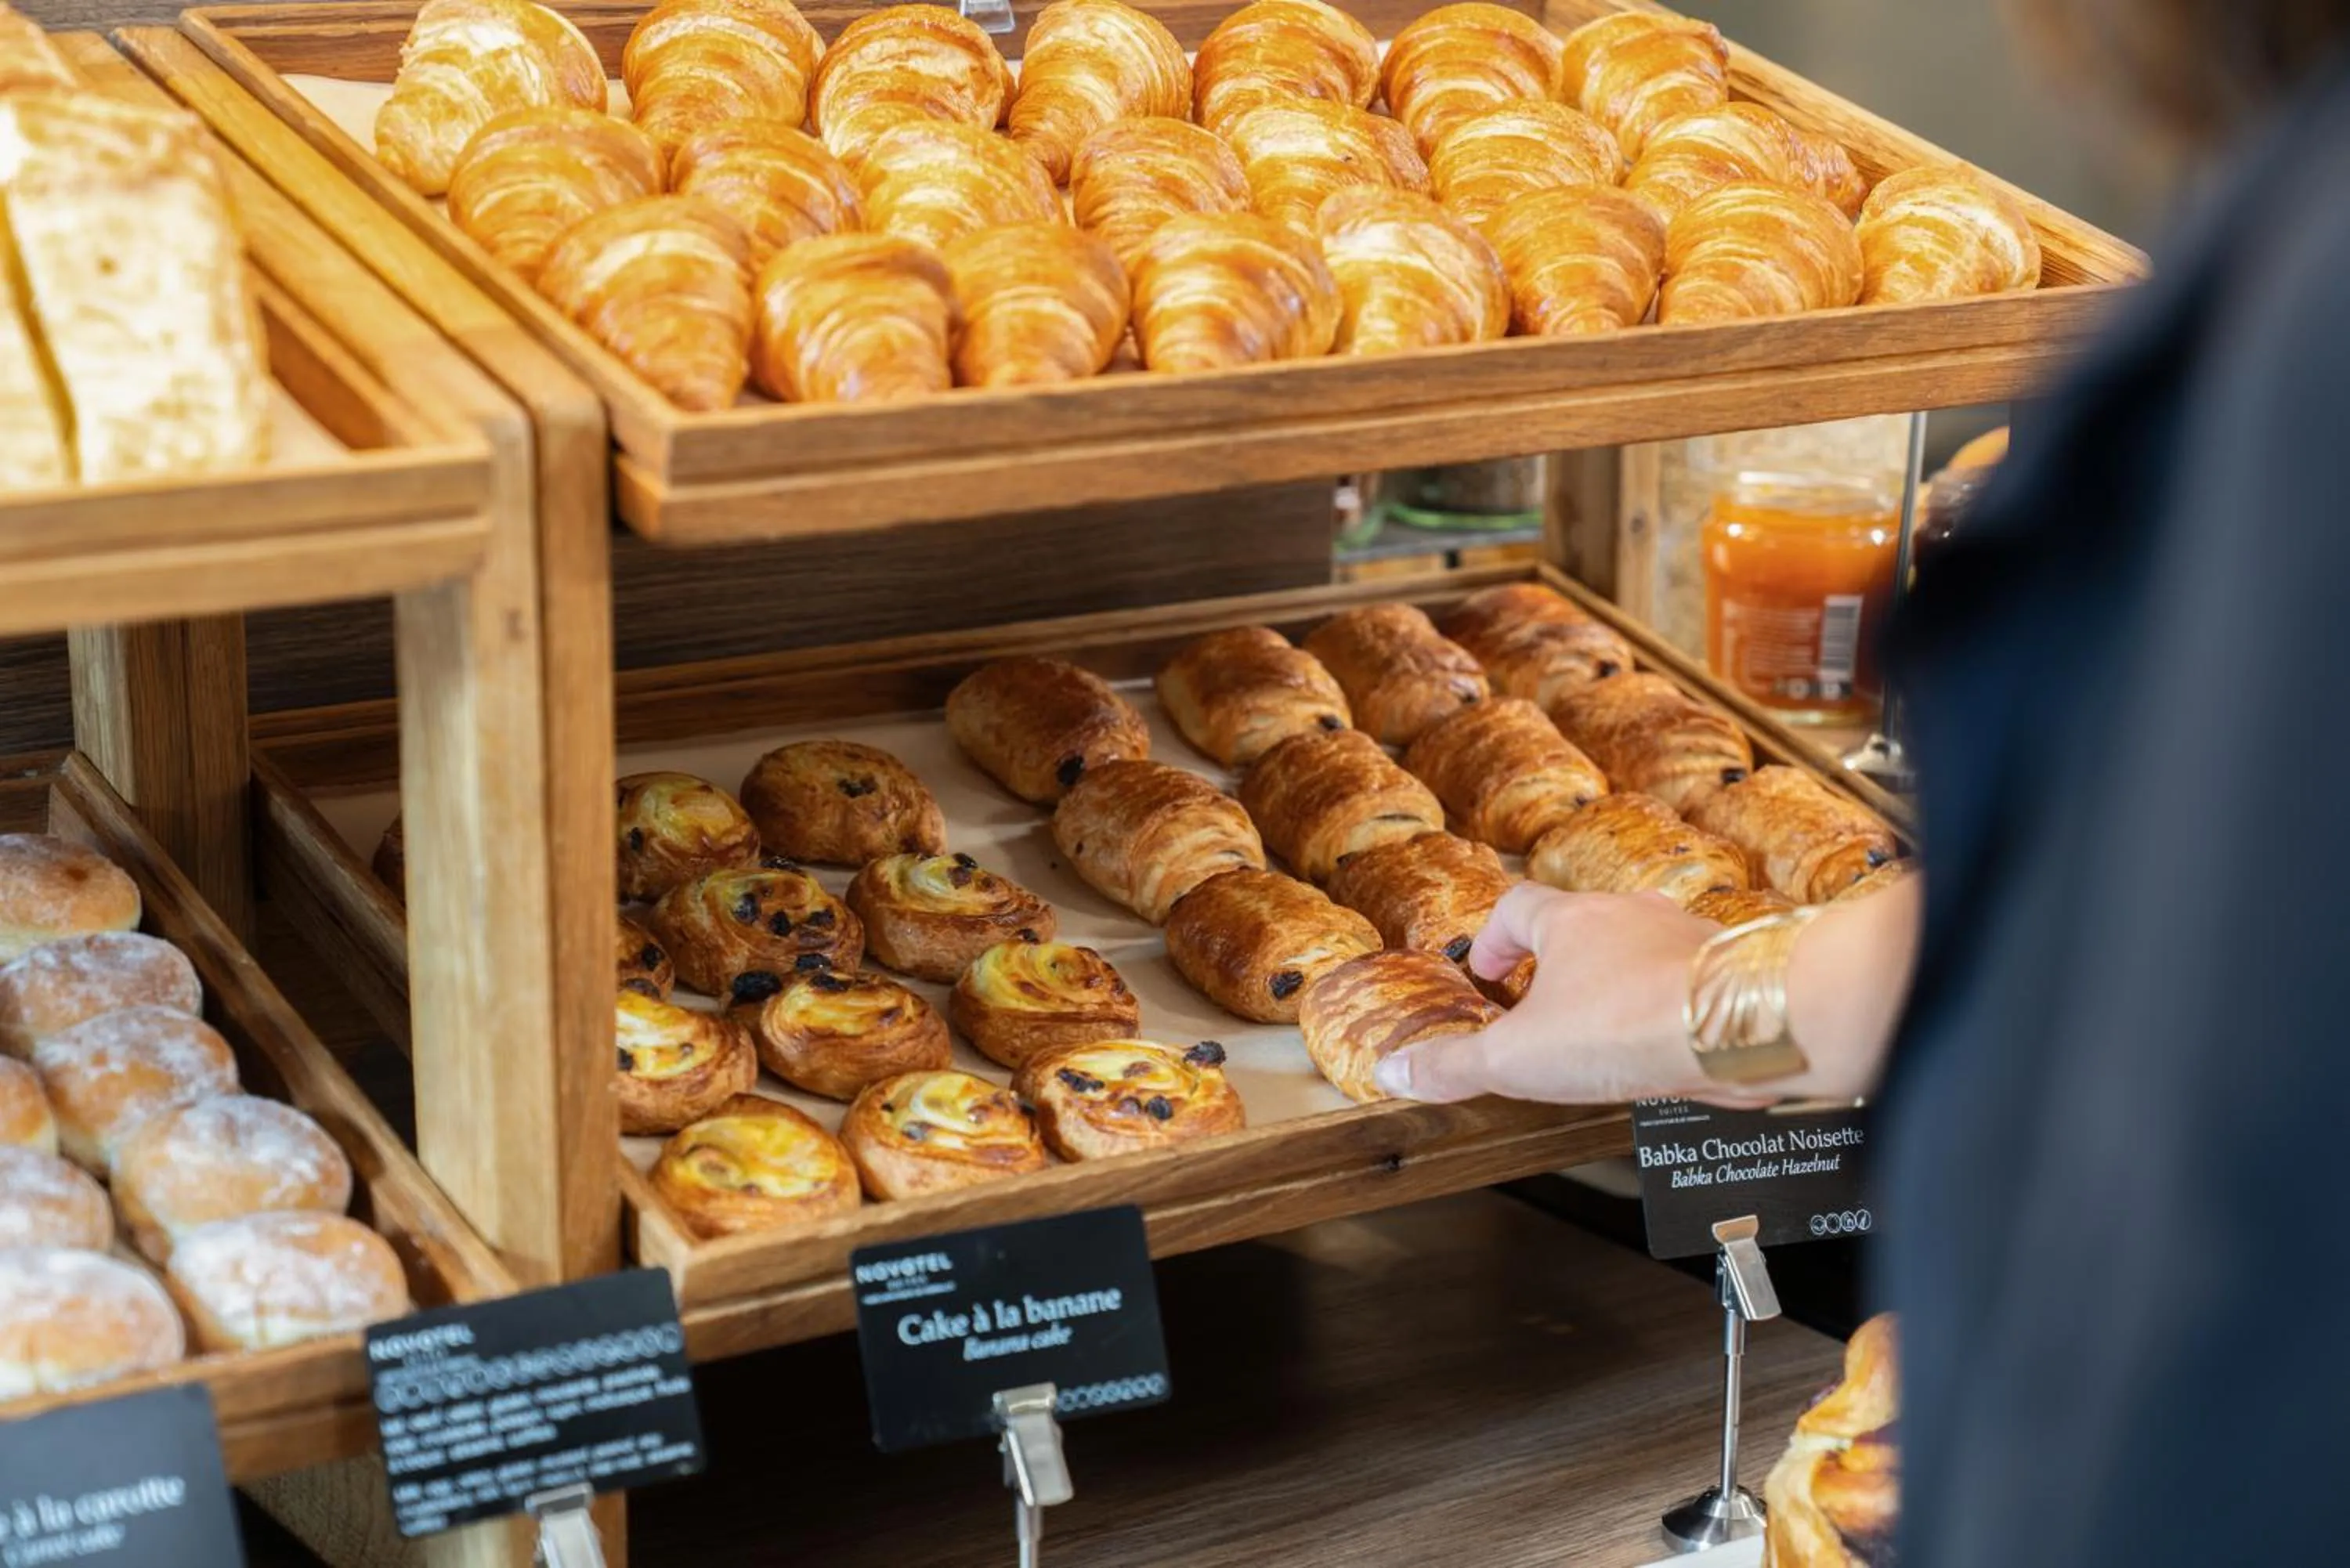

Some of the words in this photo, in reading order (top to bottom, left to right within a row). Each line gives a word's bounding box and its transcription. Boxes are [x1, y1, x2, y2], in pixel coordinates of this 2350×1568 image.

[1640, 1143, 1697, 1168] Babka
[1702, 1134, 1786, 1161] Chocolat
[1789, 1127, 1864, 1151] Noisette
[1671, 1165, 1712, 1188] Babka
[1716, 1158, 1780, 1184] Chocolate
[1782, 1153, 1841, 1176] Hazelnut
[855, 1252, 953, 1284] NOVOTEL
[898, 1310, 970, 1346] Cake
[972, 1302, 991, 1333] à
[994, 1298, 1021, 1330] la
[1023, 1288, 1123, 1324] banane
[369, 1323, 475, 1362] NOVOTEL
